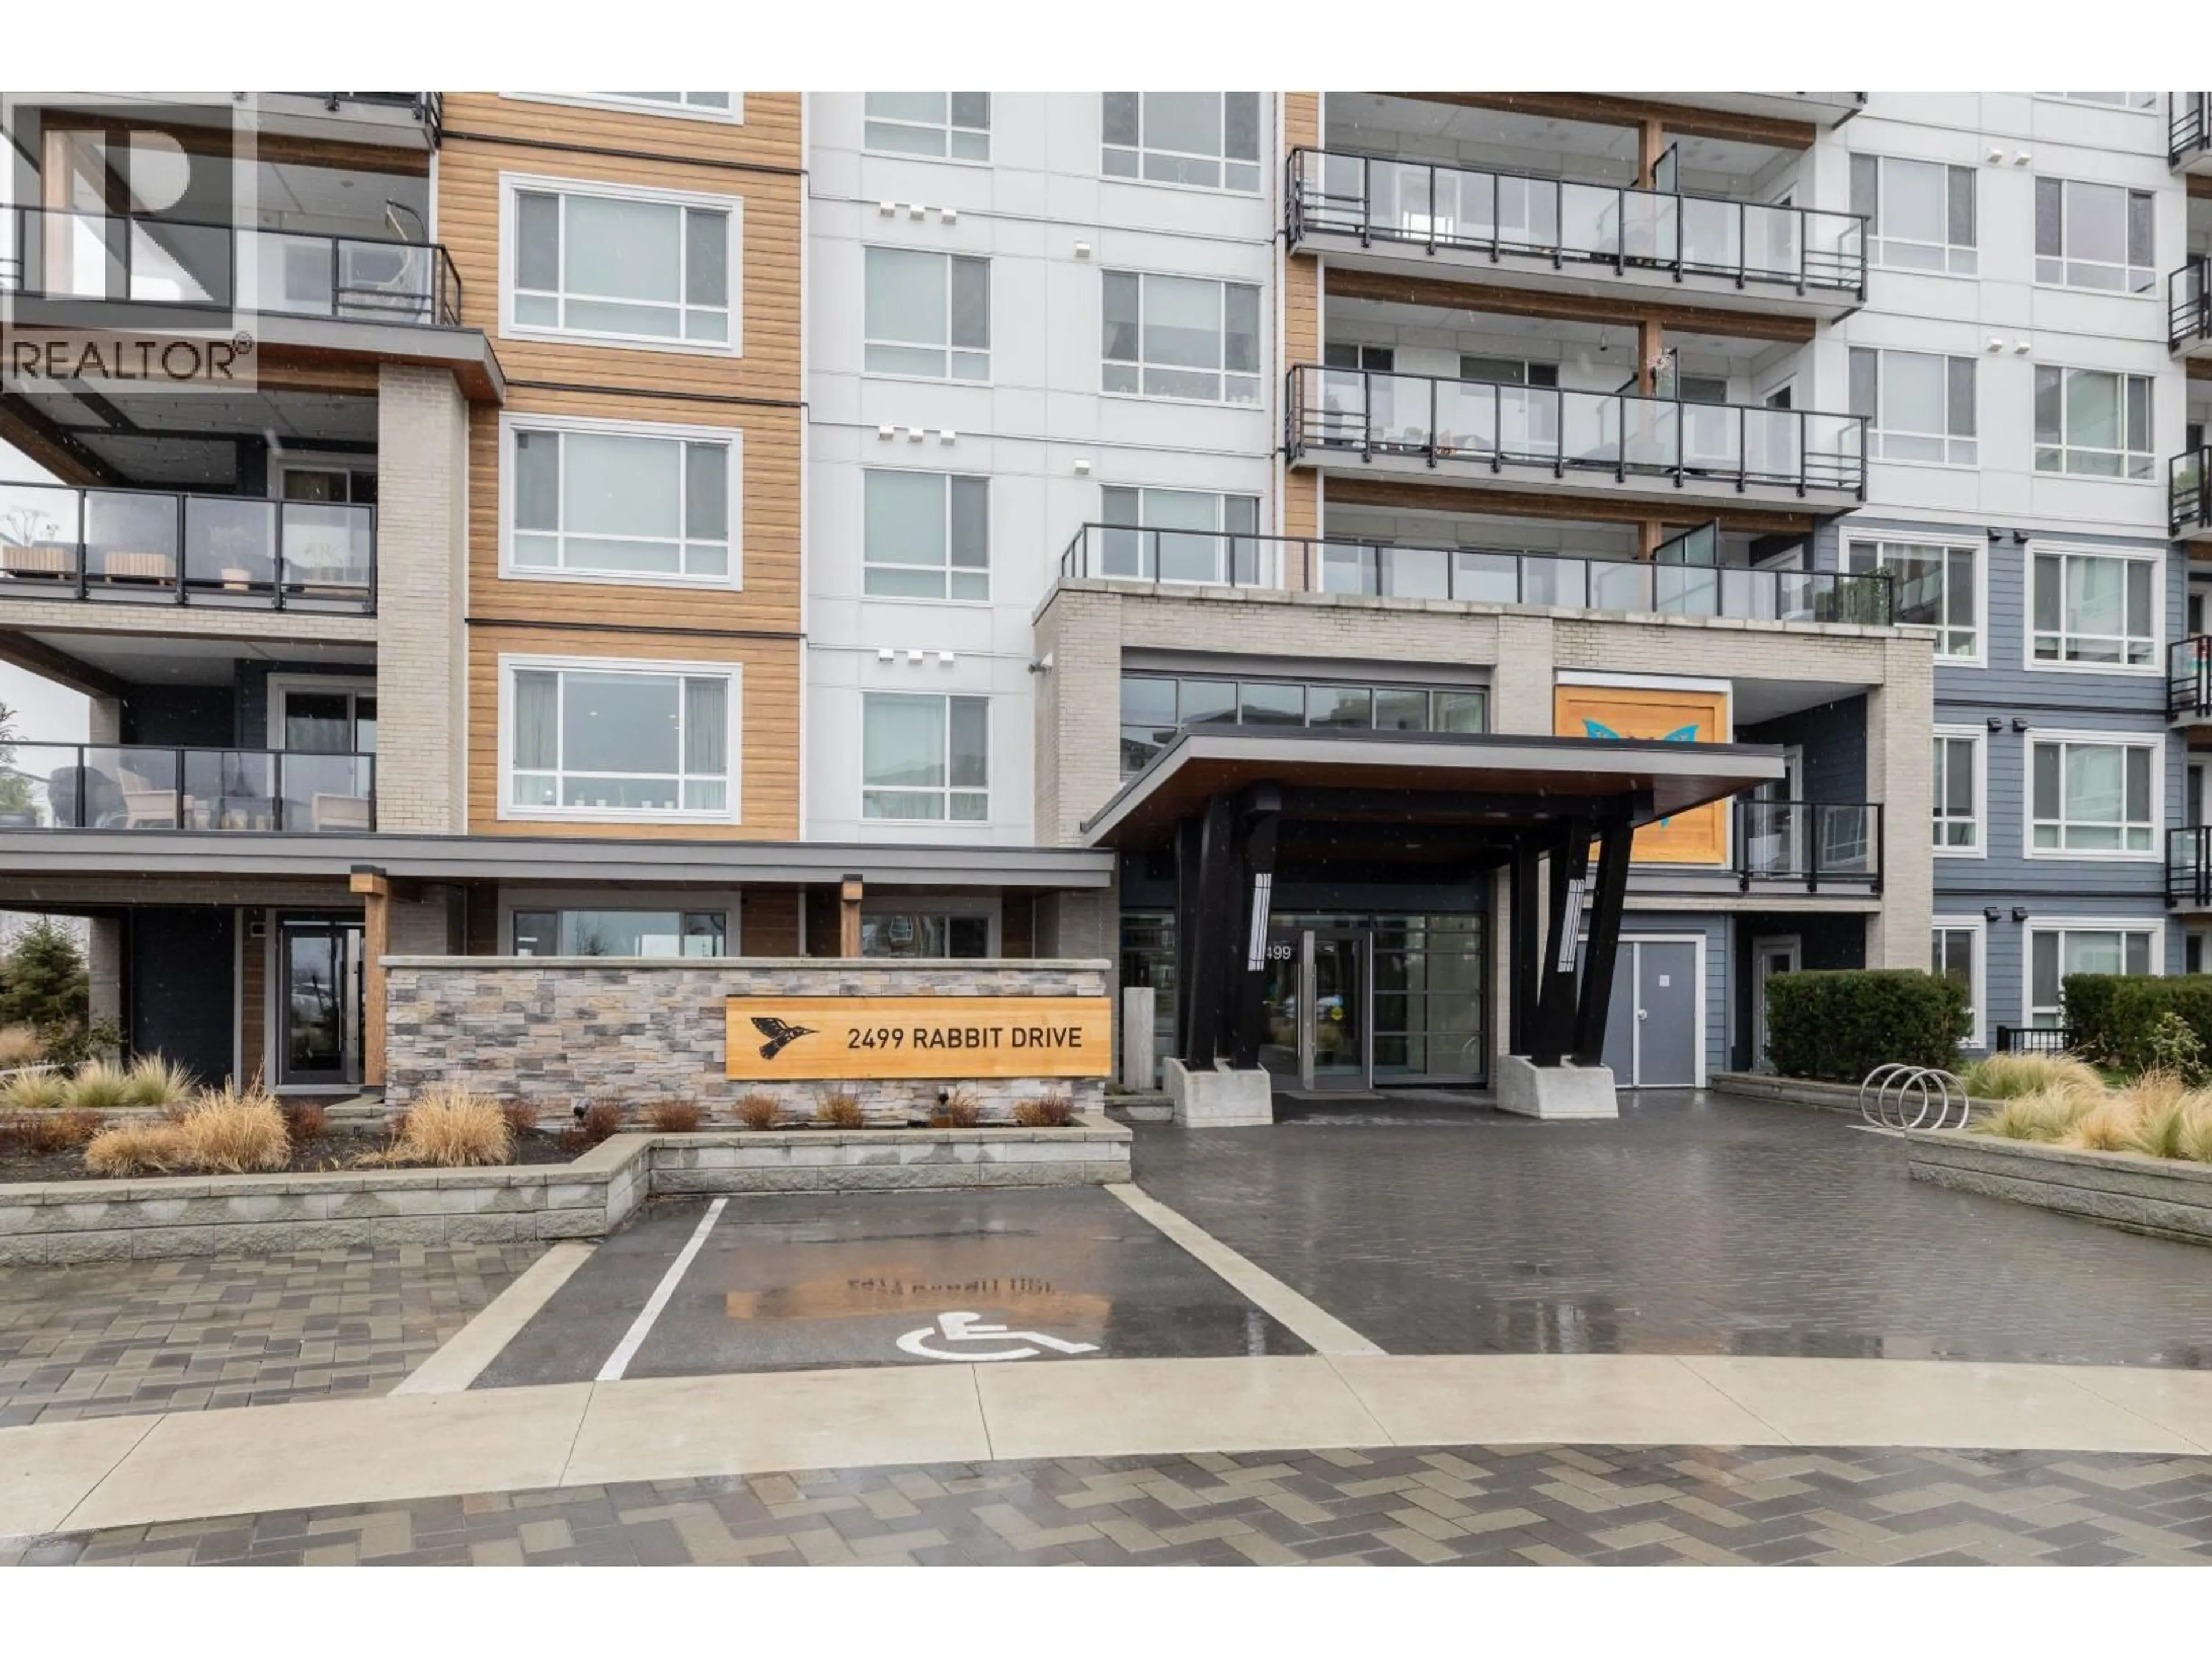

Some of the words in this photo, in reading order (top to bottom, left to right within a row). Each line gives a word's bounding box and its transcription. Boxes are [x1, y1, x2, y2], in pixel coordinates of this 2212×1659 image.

[847, 1028, 904, 1049] 2499
[913, 1027, 1003, 1048] RABBIT
[1011, 1027, 1082, 1048] DRIVE
